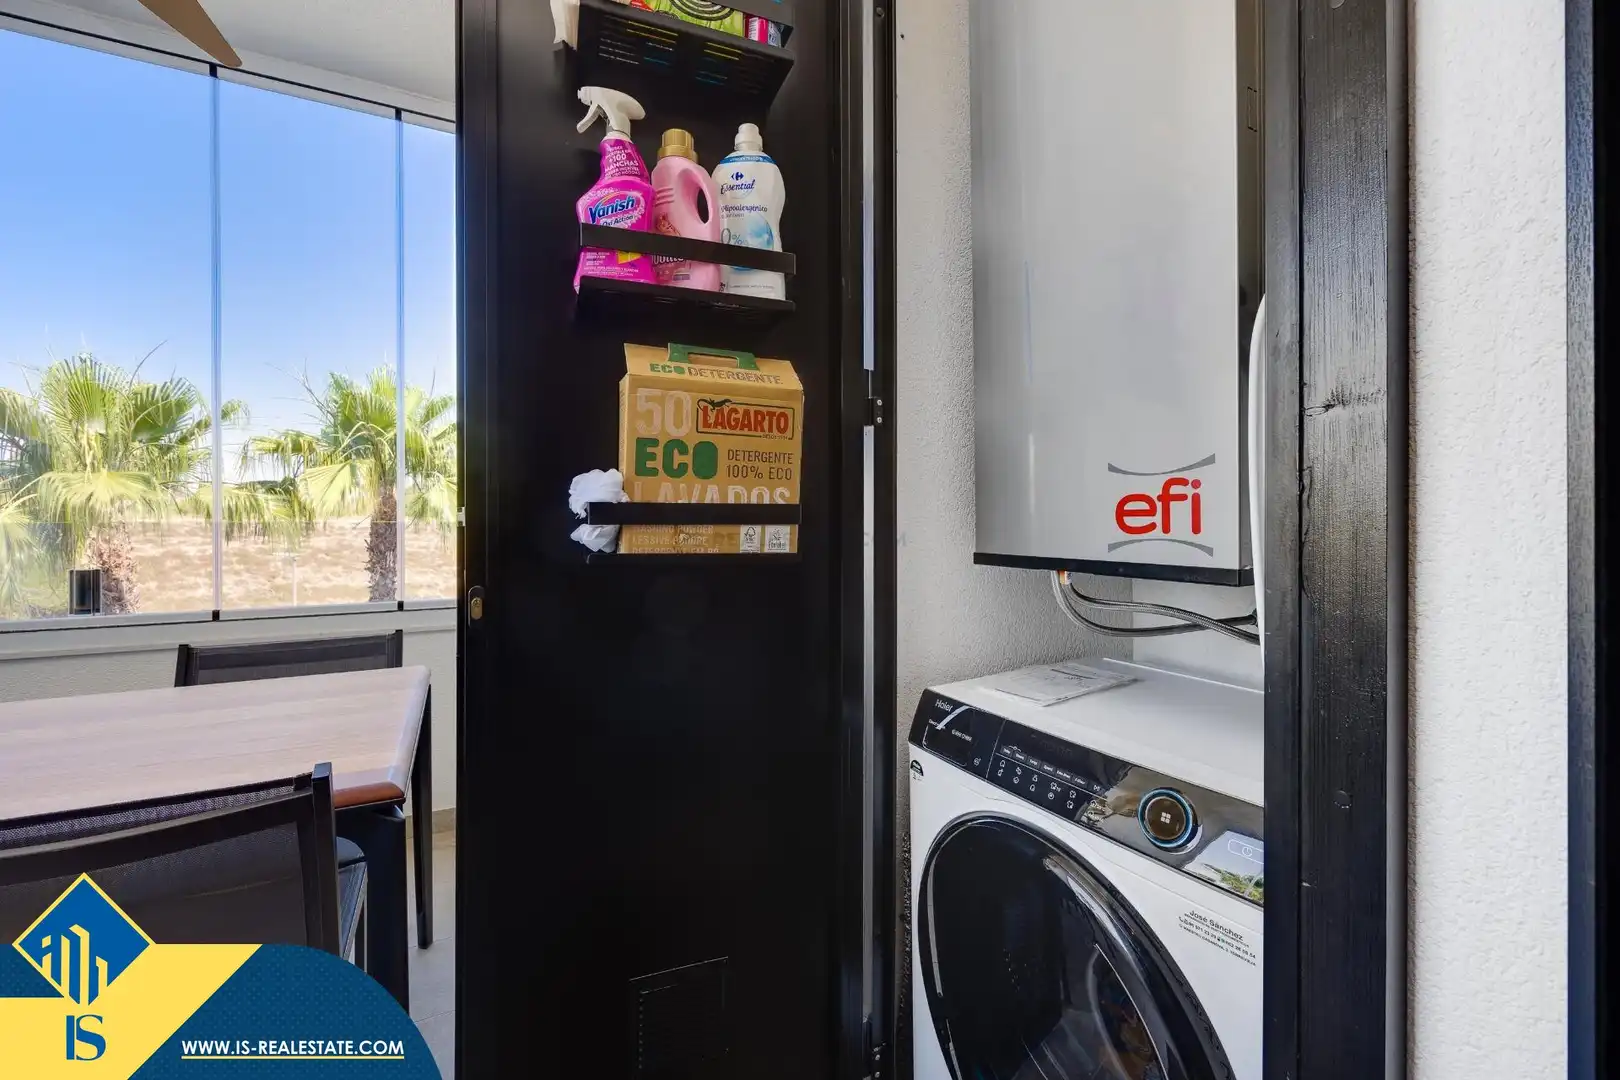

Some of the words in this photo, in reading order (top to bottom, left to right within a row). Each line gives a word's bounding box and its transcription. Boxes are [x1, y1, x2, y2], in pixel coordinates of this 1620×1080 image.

[605, 160, 639, 172] MANCHAS
[720, 179, 756, 195] Essential
[588, 195, 636, 224] Vanish
[614, 214, 634, 224] Action
[650, 362, 686, 375] ECO
[687, 366, 783, 384] DETERGENTE
[635, 387, 692, 437] 50
[702, 404, 789, 435] LAGARTO
[634, 437, 719, 480] ECO
[727, 449, 794, 465] DETERGENTE
[726, 465, 764, 480] 100%
[768, 467, 793, 481] ECO
[1115, 477, 1202, 535] efi
[934, 699, 953, 712] Haier
[1189, 910, 1208, 923] José
